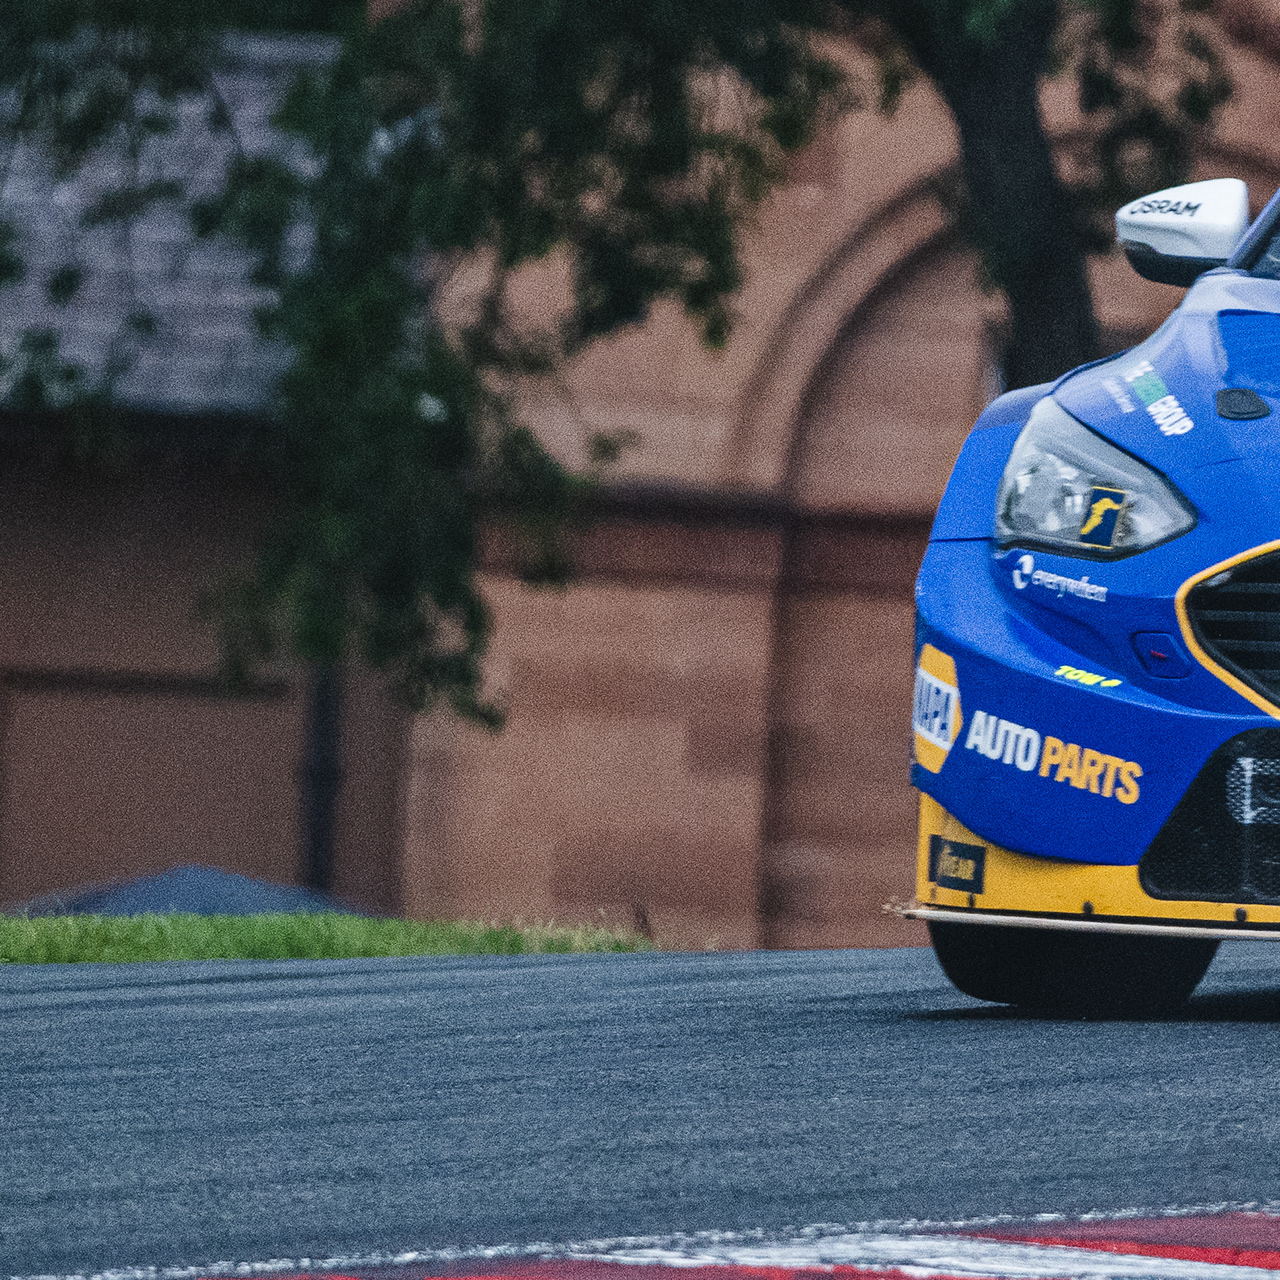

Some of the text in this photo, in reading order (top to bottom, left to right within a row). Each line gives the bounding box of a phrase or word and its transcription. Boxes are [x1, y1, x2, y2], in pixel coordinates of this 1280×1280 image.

[1054, 665, 1107, 686] TOW
[964, 710, 1144, 805] AUTO PARTS
